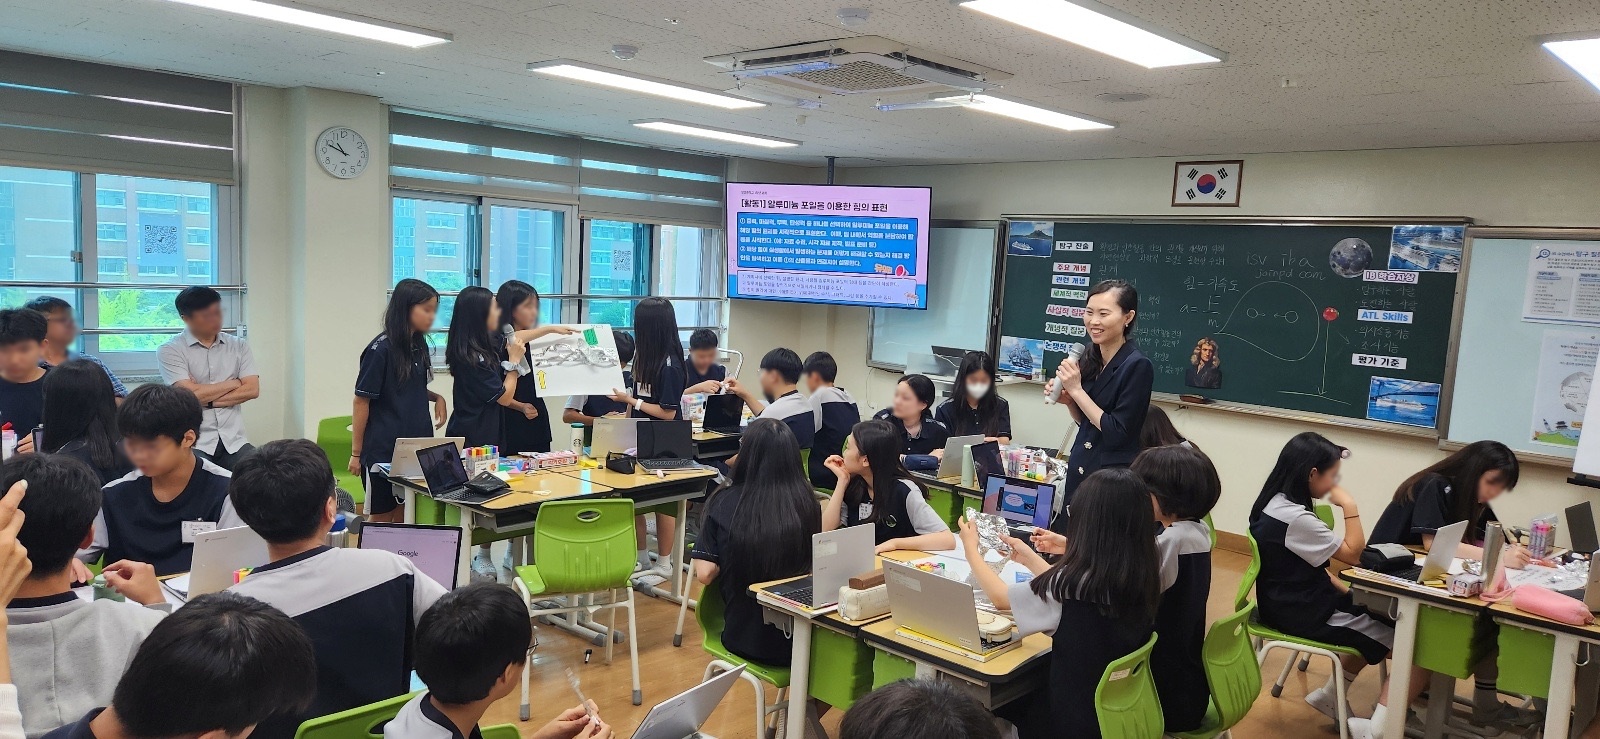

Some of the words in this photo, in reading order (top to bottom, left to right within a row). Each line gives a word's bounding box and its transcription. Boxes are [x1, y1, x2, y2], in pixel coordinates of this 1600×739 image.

[322, 146, 327, 154] 9
[361, 150, 366, 158] 3
[325, 156, 330, 164] 8
[742, 198, 766, 208] [활동1]
[768, 200, 798, 209] 알루미늄
[801, 201, 824, 210] 포일을
[827, 202, 851, 210] 이용한
[853, 202, 869, 211] 힘의
[872, 203, 888, 212] 표현
[1366, 271, 1376, 280] IB
[1378, 272, 1415, 282] 학습자상
[1184, 276, 1196, 290] 힘
[1207, 276, 1239, 293] 가속도
[1048, 306, 1069, 316] 사실적
[1361, 312, 1379, 320] ATL
[1382, 312, 1408, 321] Skills
[1046, 324, 1068, 334] 개념적
[1070, 327, 1085, 335] 질문
[1395, 328, 1409, 340] 기능
[1045, 341, 1066, 351] 논쟁적
[1384, 340, 1399, 353] 기능
[1359, 356, 1377, 365] 평가
[1381, 358, 1399, 367] 기준
[397, 550, 419, 558] Google
